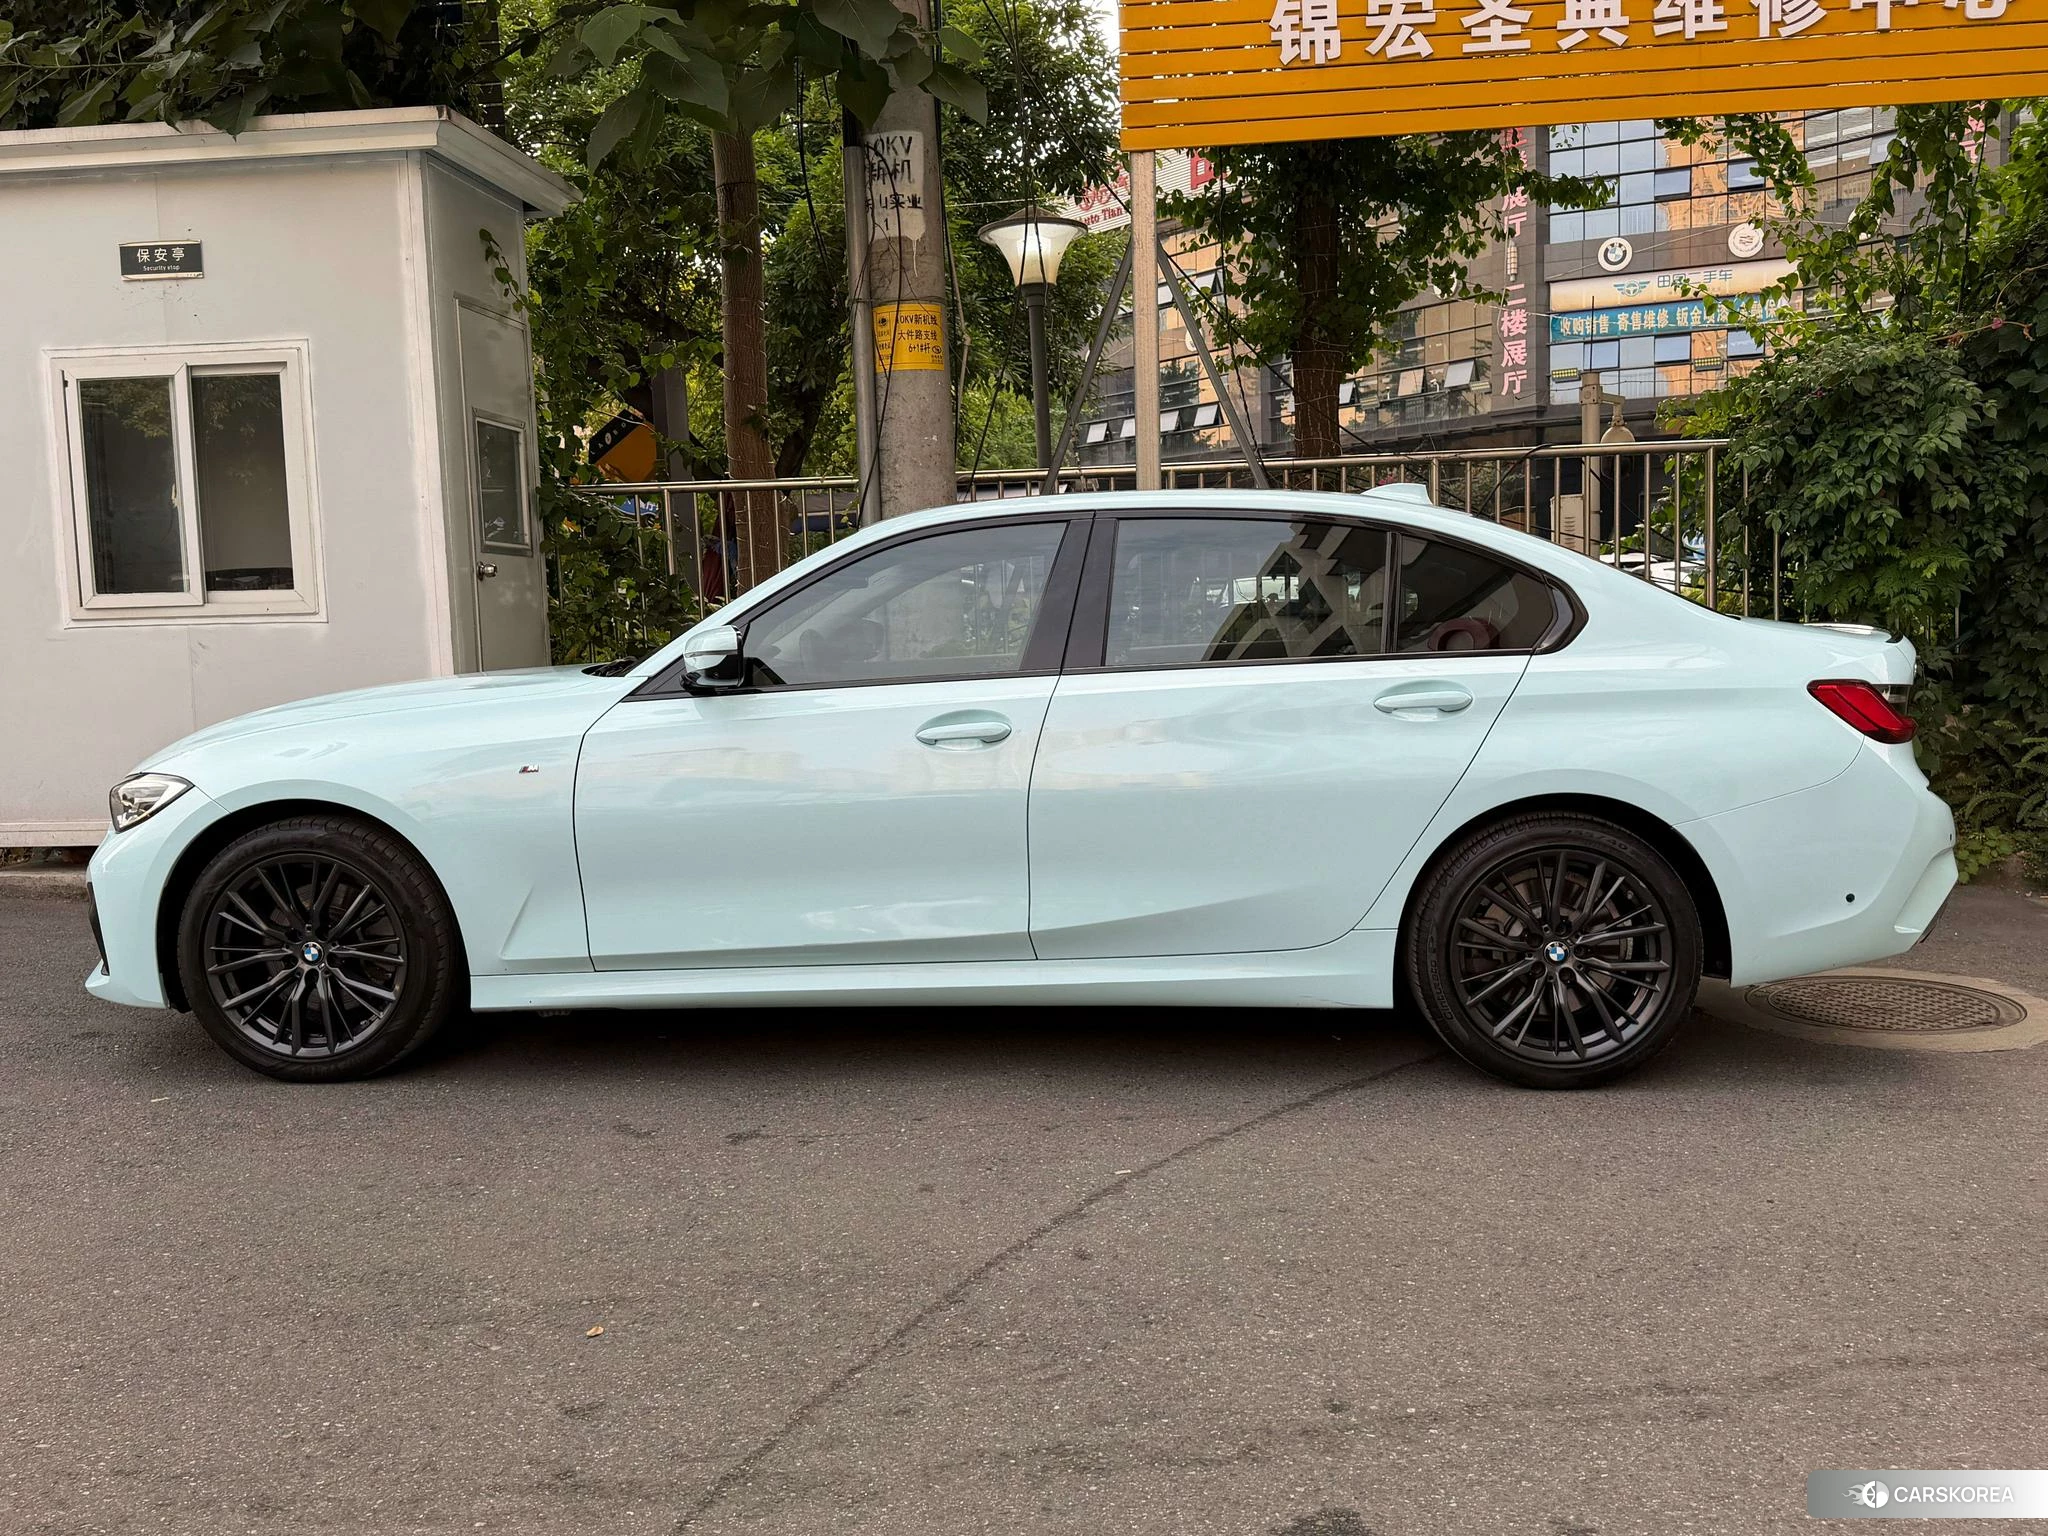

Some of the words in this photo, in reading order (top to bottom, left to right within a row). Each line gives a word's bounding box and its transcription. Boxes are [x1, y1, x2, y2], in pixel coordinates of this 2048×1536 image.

[1268, 0, 2010, 66] 锦宏圣典维修
[136, 247, 185, 263] 保安亭
[1500, 282, 1528, 397] 二楼展厅
